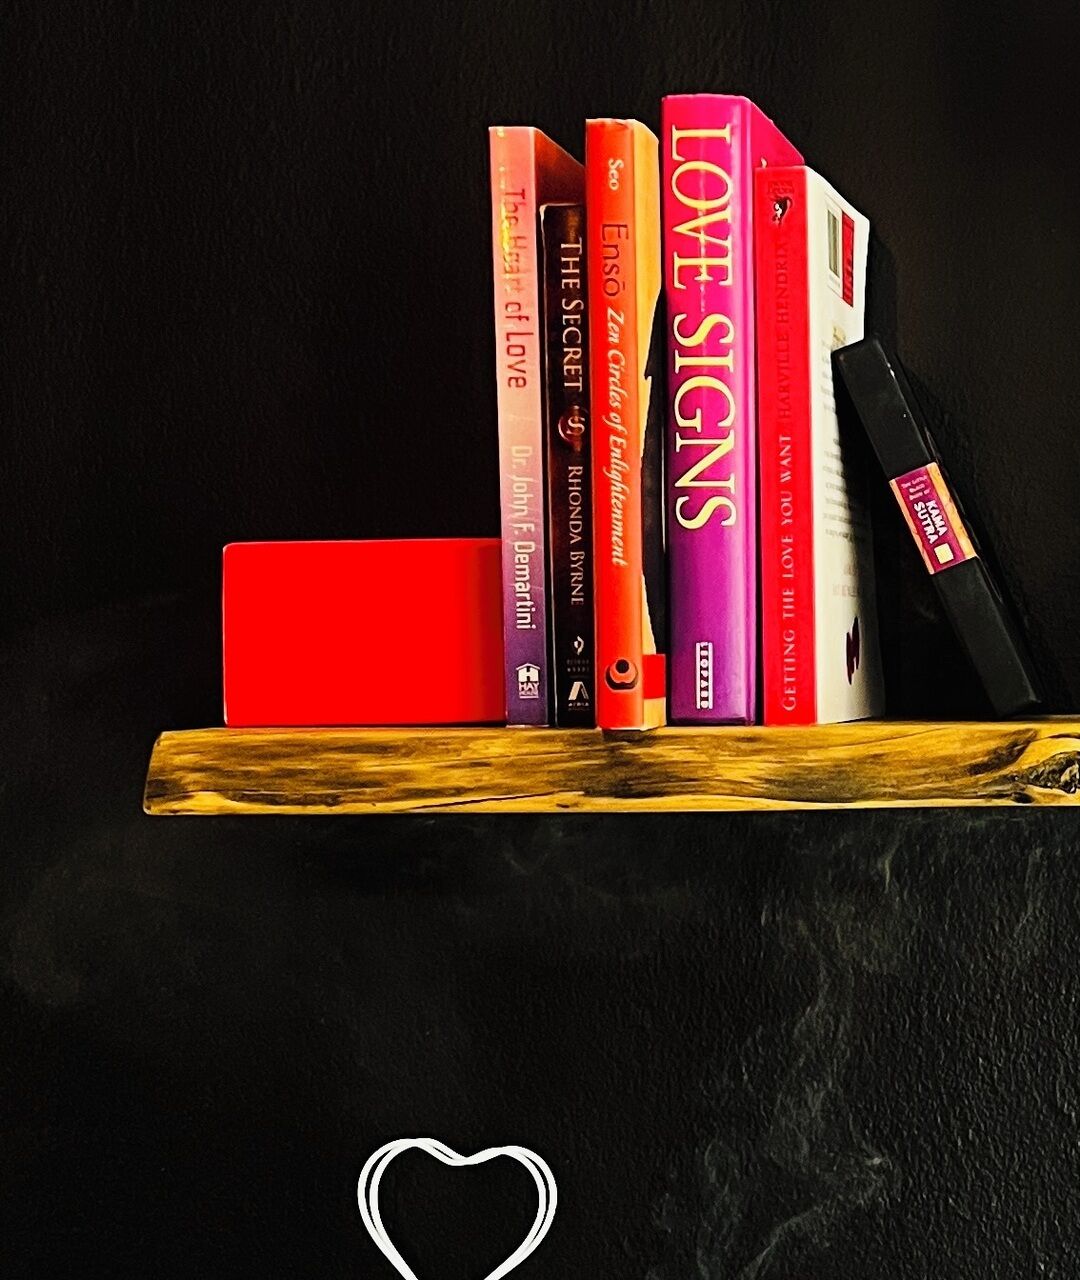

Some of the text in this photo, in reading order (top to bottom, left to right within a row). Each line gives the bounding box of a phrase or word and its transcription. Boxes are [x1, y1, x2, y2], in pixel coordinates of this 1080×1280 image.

[608, 157, 625, 191] Seo
[504, 188, 534, 388] The Heart of Love
[559, 237, 584, 392] THE SECRET
[606, 307, 625, 343] Zen
[670, 124, 736, 529] LOVE SIGNS
[602, 410, 627, 435] of
[607, 349, 627, 409] Circles
[509, 444, 536, 630] Dr. John F. Demartini
[567, 464, 585, 607] RHONDA BYRNE
[603, 434, 629, 567] Enlightenment
[913, 501, 940, 544] SUTRA
[925, 499, 948, 537] KAMA
[780, 434, 795, 712] GETTING THE LOVE YOU WANT
